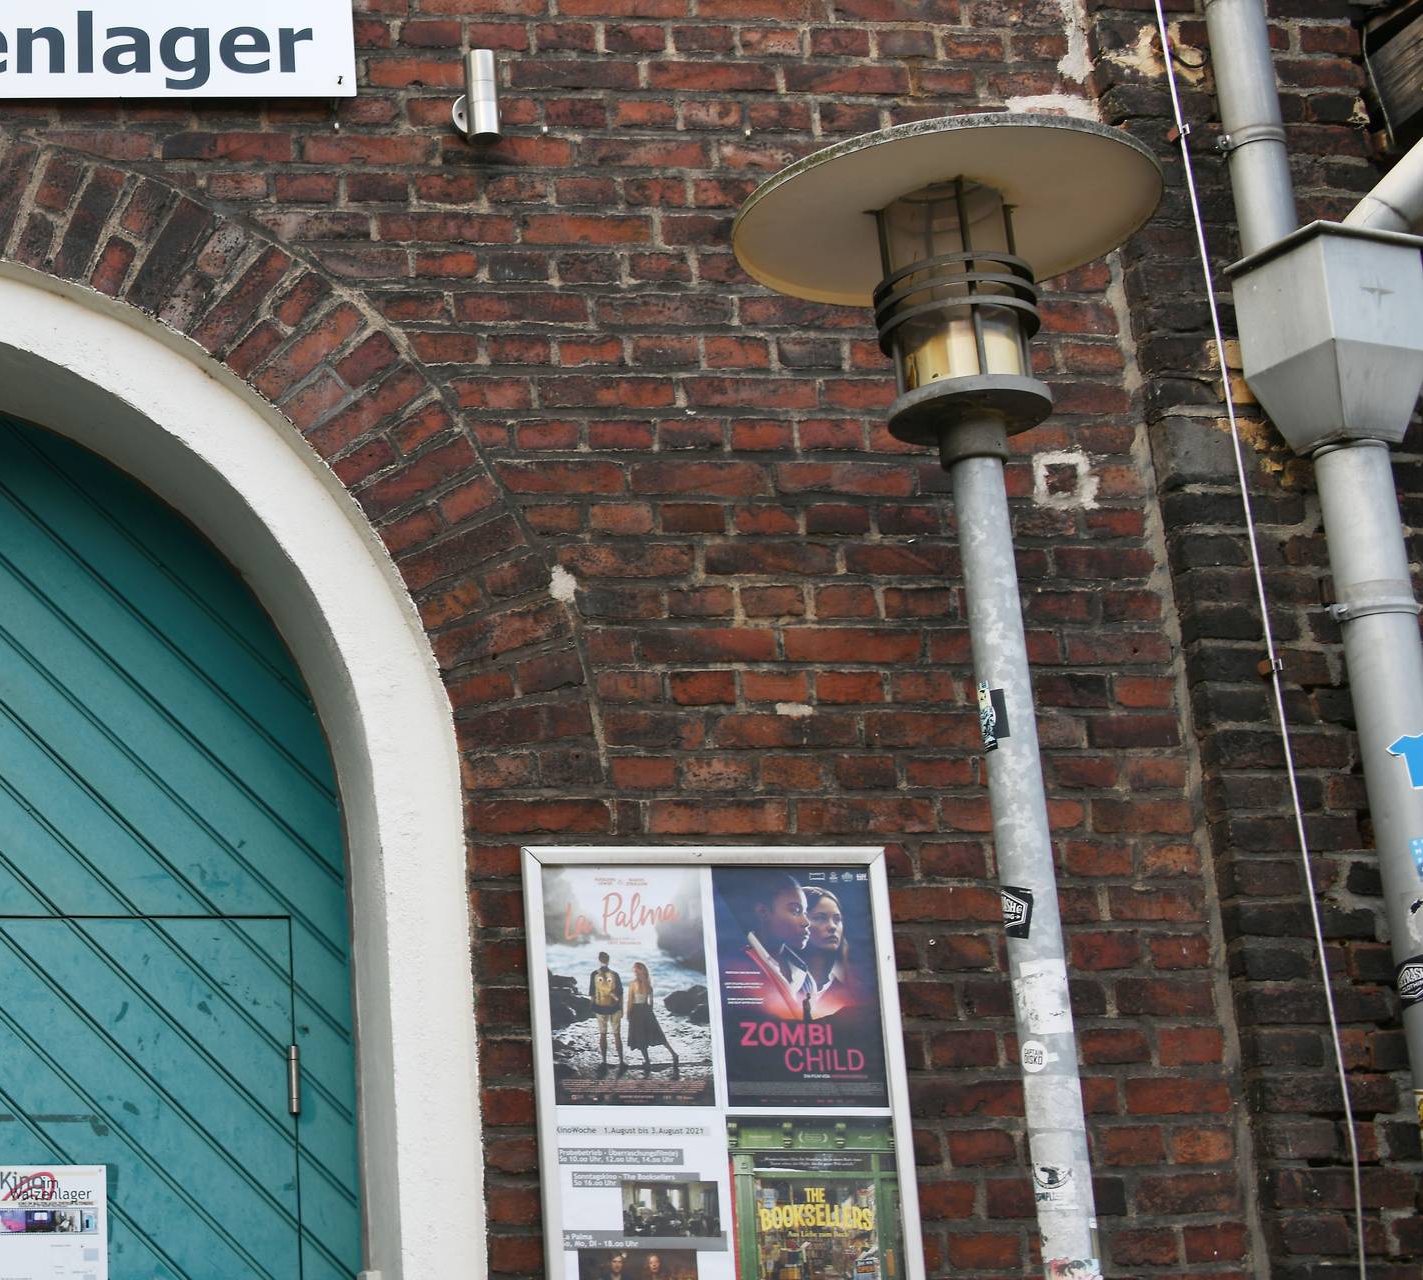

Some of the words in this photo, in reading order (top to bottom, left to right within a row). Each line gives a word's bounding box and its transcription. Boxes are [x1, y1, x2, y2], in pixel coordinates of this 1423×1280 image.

[564, 902, 595, 941] La
[601, 891, 681, 937] Palma
[739, 1022, 833, 1047] ZOMBI
[784, 1047, 865, 1073] CHILD
[1024, 1054, 1043, 1065] DISKO
[685, 1127, 704, 1135] 2021
[0, 1171, 44, 1189] Kino
[42, 1176, 59, 1189] im
[10, 1187, 92, 1203] Walzenlager
[803, 1187, 826, 1203] THE
[759, 1203, 874, 1232] BOOKSELLERS
[571, 1232, 594, 1240] Palma
